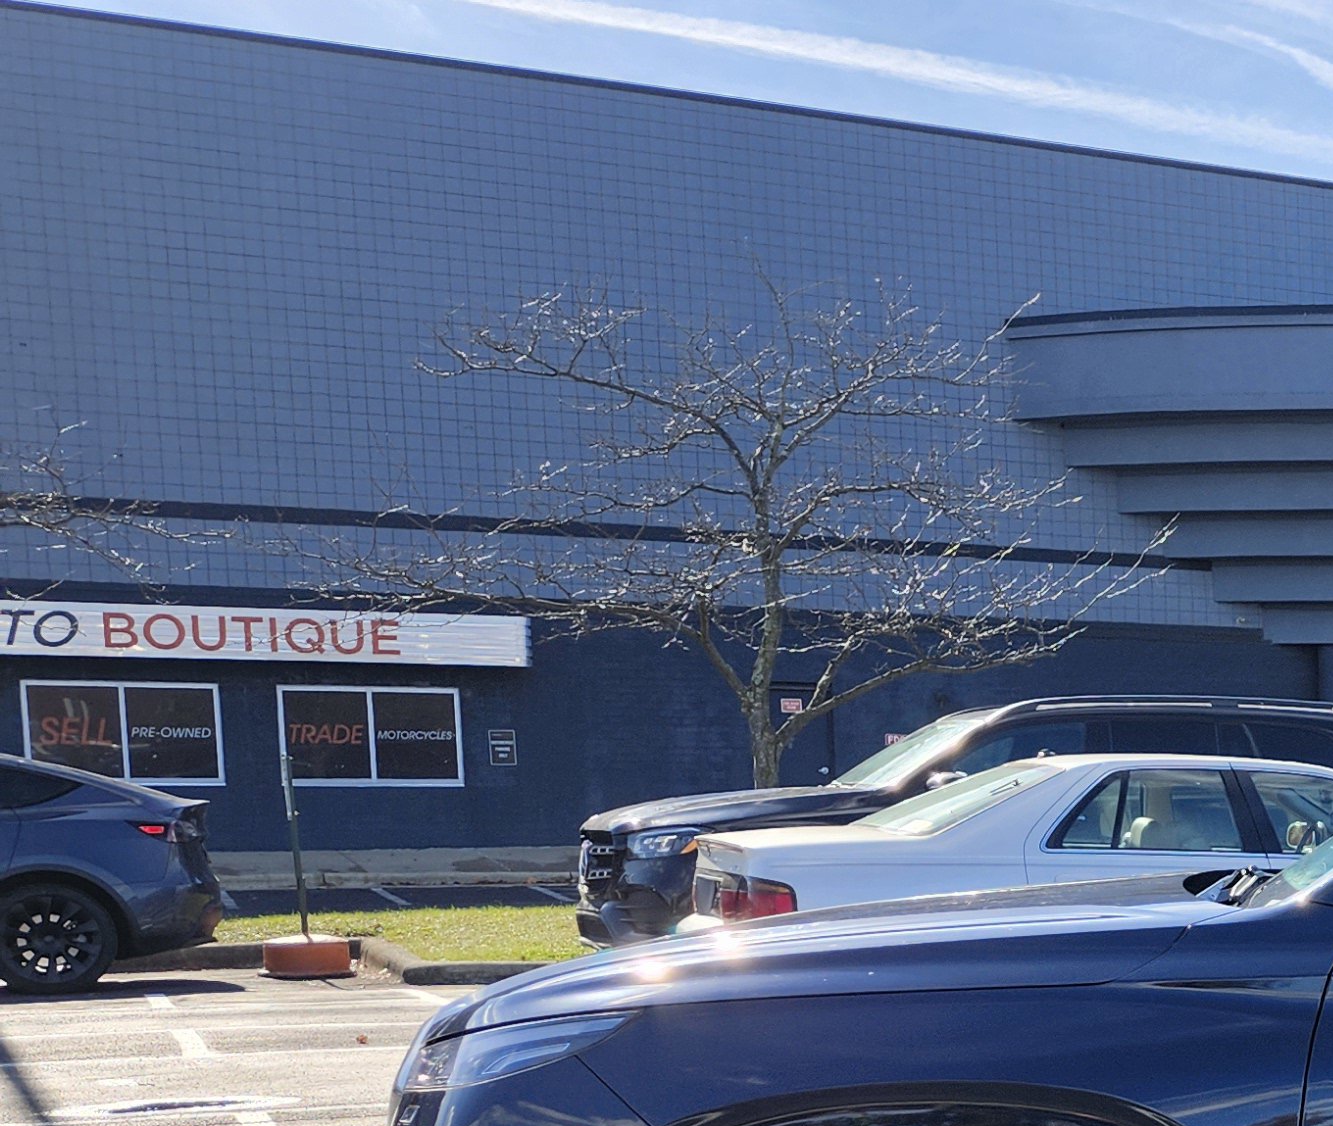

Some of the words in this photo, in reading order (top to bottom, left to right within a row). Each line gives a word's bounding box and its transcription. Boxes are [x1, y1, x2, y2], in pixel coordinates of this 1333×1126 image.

[102, 611, 401, 655] BOUTIQUE
[39, 716, 114, 746] SELL
[131, 727, 212, 738] PRE-OWNED
[289, 724, 364, 745] TRADE
[377, 729, 453, 741] MOTORCYCLES
